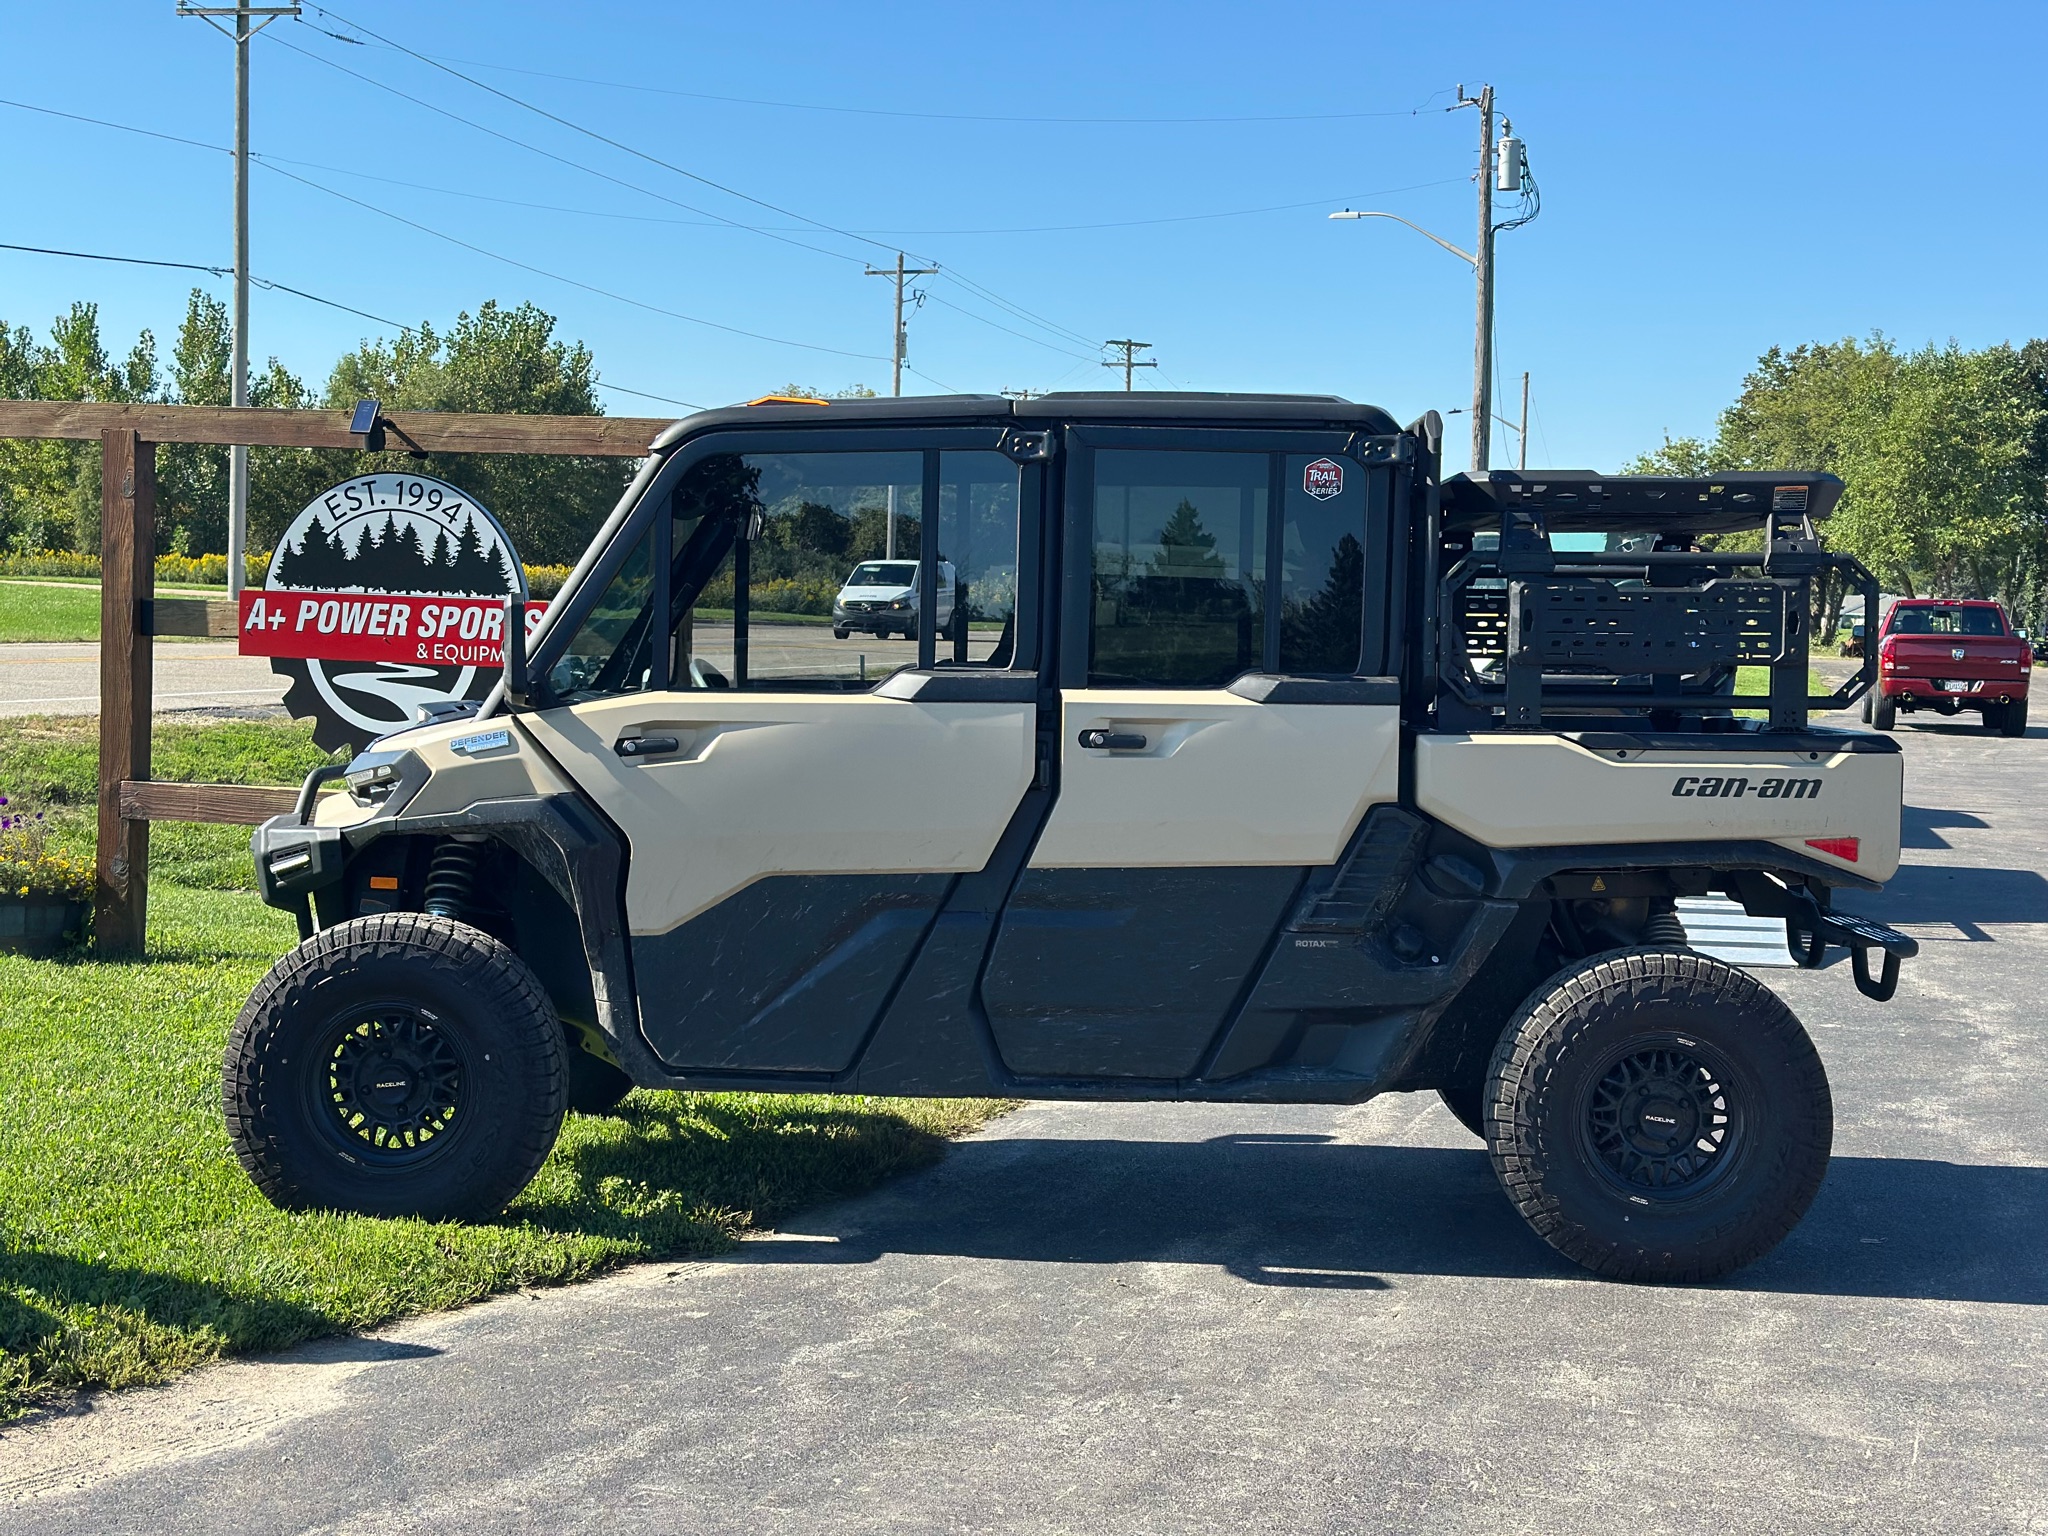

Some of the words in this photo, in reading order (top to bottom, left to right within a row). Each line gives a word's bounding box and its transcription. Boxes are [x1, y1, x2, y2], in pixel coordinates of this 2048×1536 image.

[1309, 470, 1338, 481] TRAIL
[324, 480, 386, 522] EST.
[395, 480, 463, 524] 1994
[245, 598, 287, 631] A+
[295, 600, 411, 637] POWER
[417, 604, 544, 641] SPORS
[416, 642, 429, 659] &
[433, 643, 505, 665] EQUIPM
[450, 731, 506, 748] DEFENDER
[1671, 777, 1823, 799] can-am
[1295, 940, 1326, 948] ROTAX
[376, 1080, 406, 1089] RACELINE
[1645, 1115, 1676, 1124] RACELINE
